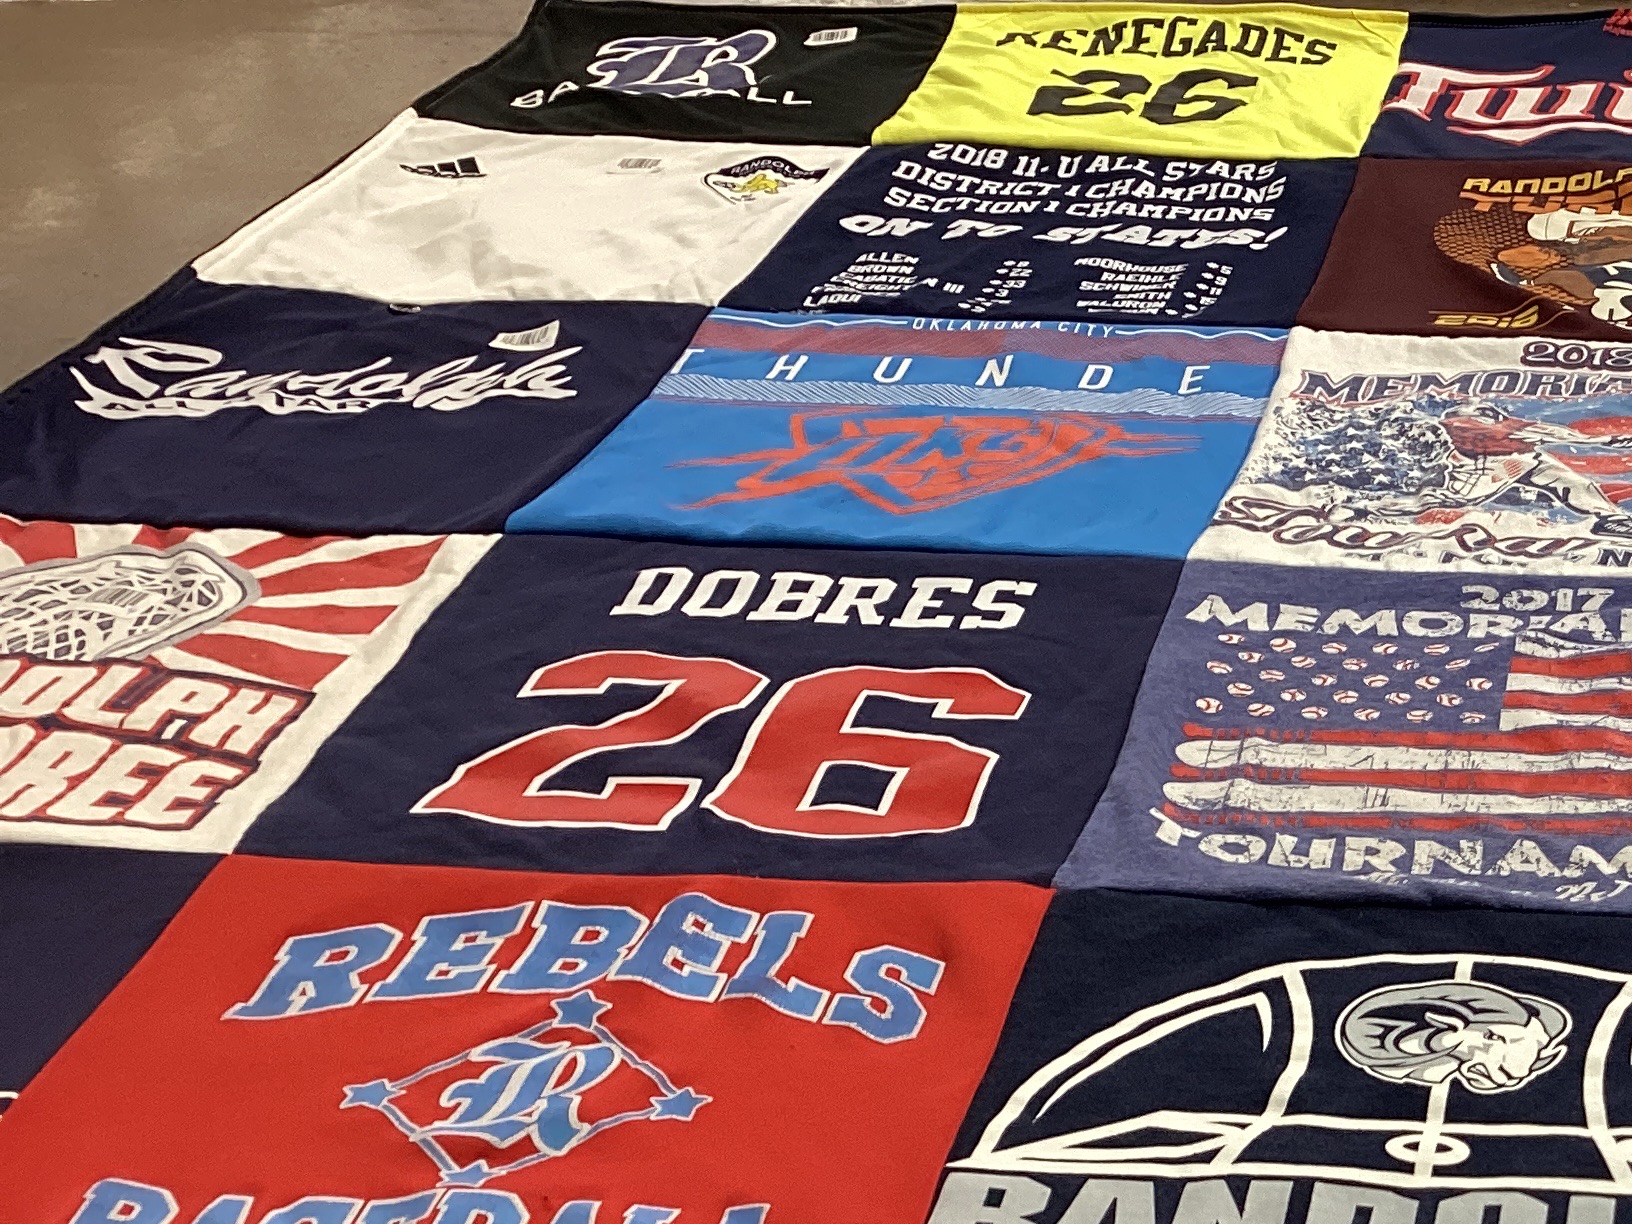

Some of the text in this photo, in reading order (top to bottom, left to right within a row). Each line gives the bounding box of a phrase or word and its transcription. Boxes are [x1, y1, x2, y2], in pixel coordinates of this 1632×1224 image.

[1026, 68, 1259, 125] 26
[927, 143, 1005, 172] 2018
[1085, 155, 1157, 176] ALL
[1162, 161, 1277, 182] STARS
[892, 161, 1061, 198] DISTRICT
[1084, 177, 1286, 204] CHAMPIONS
[883, 186, 1038, 215] SECTION
[1065, 200, 1276, 223] CHAMPIONS
[838, 214, 935, 240] ON
[941, 218, 1024, 241] TO
[847, 264, 915, 275] BROWN
[855, 251, 920, 264] ALLEN
[911, 316, 1115, 338] OKLAHOMA CITY
[609, 566, 1038, 630] DOBRES
[1460, 583, 1616, 612] 2017
[408, 649, 1033, 839] 26
[220, 891, 947, 1045] REBELS
